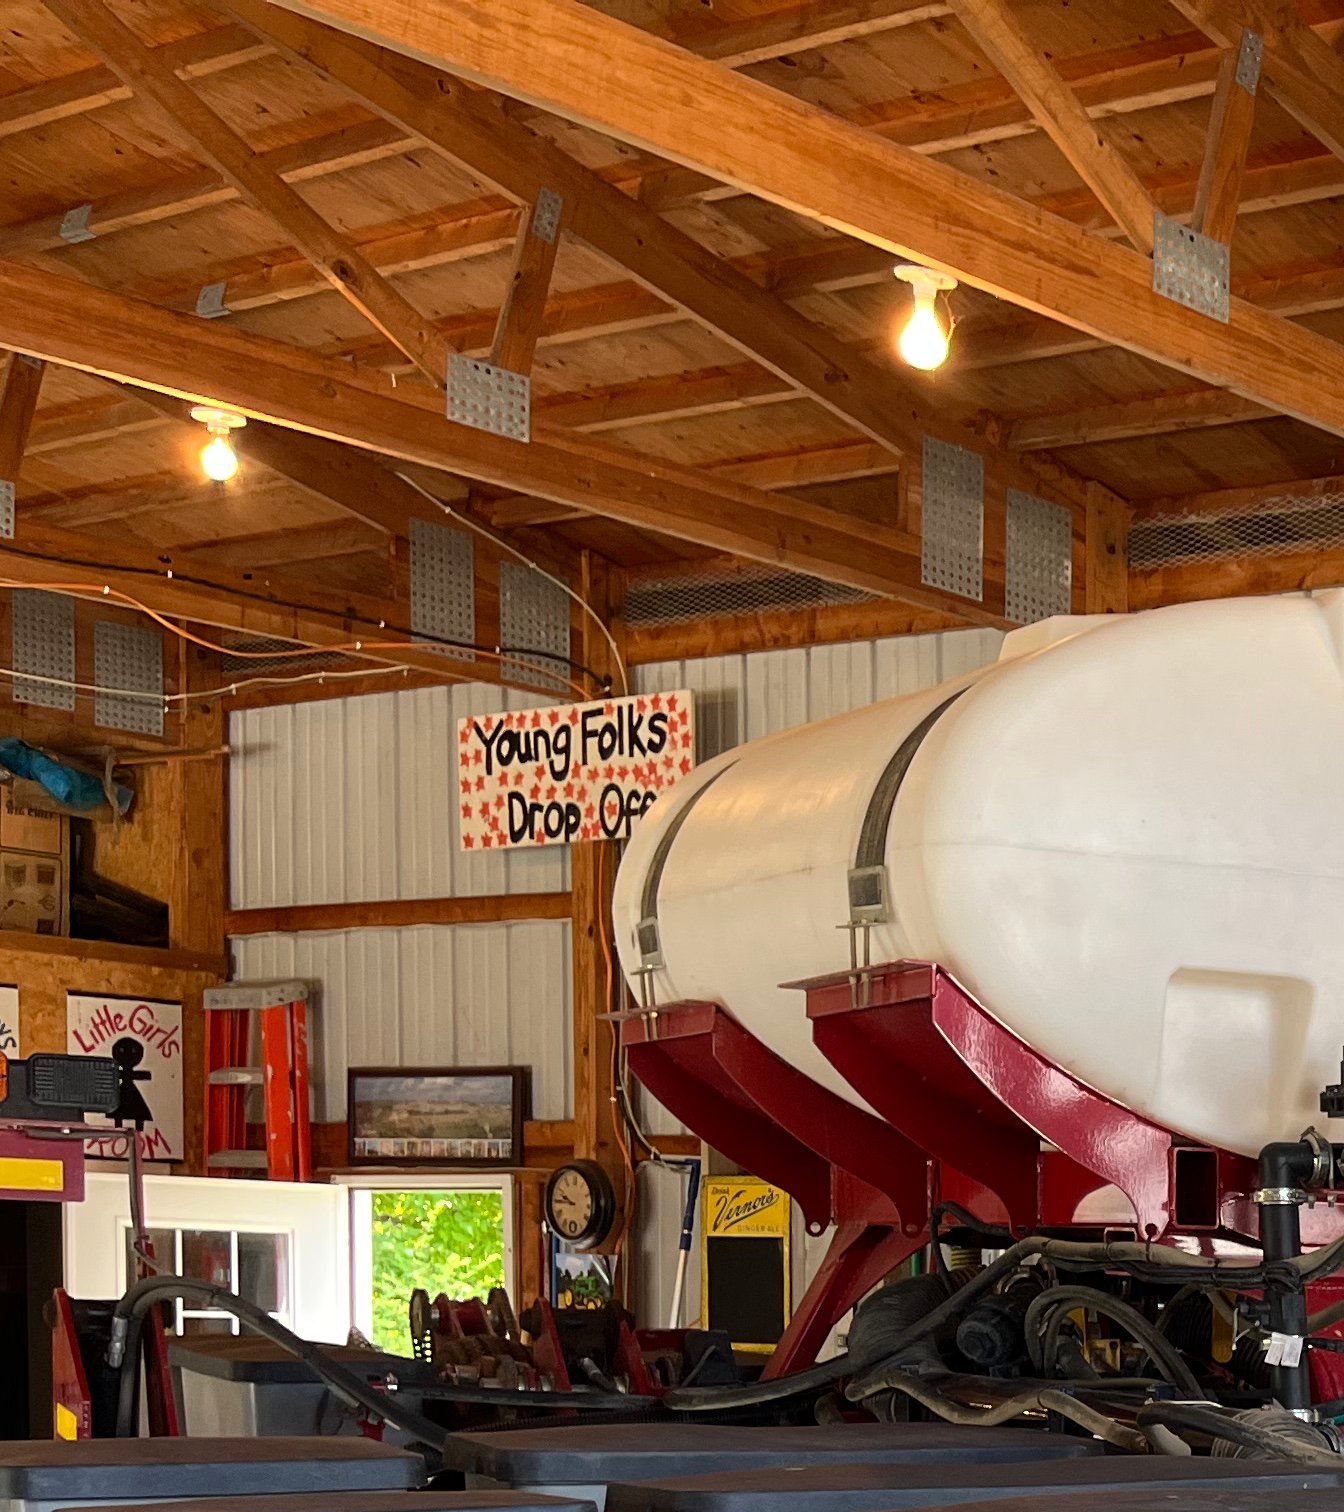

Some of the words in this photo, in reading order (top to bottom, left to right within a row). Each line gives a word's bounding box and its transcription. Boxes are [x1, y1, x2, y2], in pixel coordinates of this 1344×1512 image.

[473, 718, 572, 782] Young
[581, 703, 669, 766] Folks
[507, 790, 582, 844] Drop
[72, 1004, 128, 1054] Little
[128, 1004, 180, 1059] Girls
